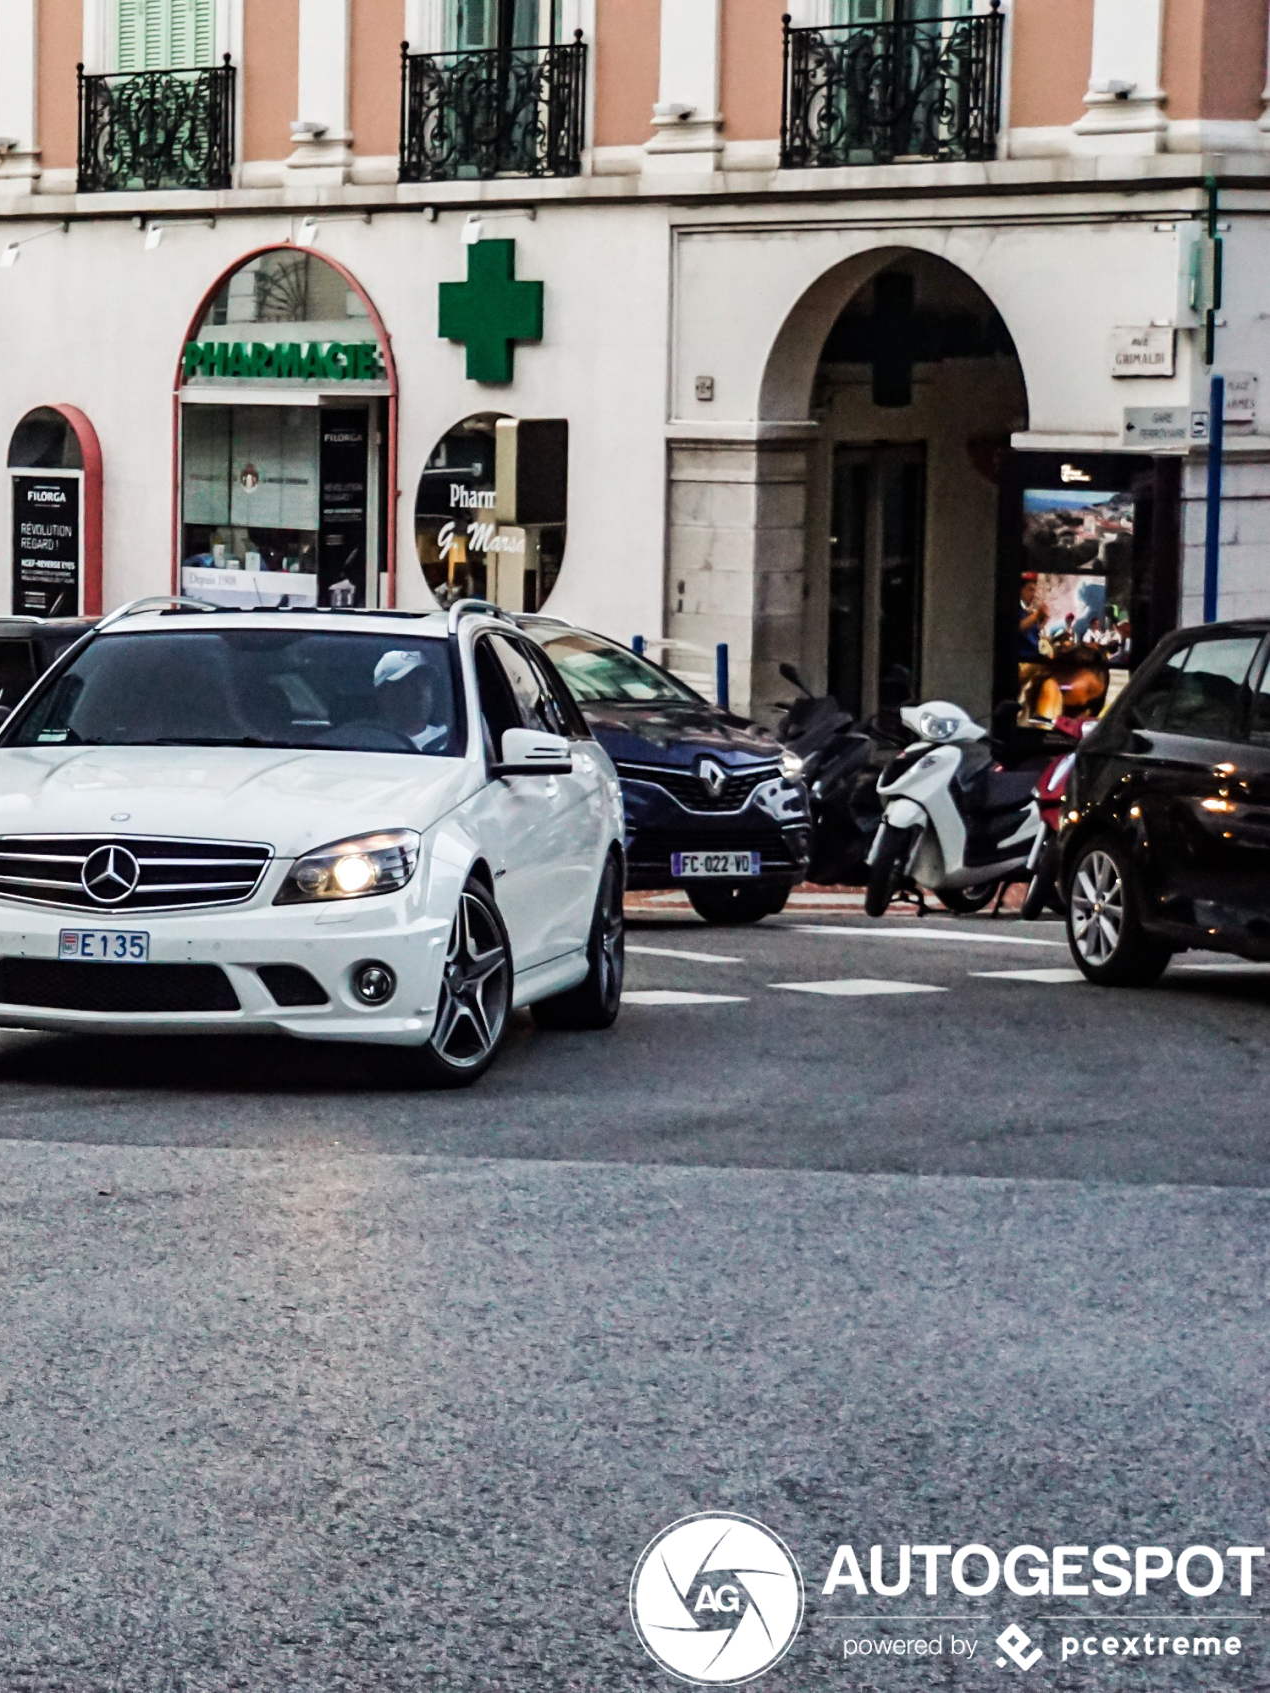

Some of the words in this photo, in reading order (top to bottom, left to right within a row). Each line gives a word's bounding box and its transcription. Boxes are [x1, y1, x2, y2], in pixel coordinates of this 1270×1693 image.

[184, 341, 377, 380] PHARMACIE
[1115, 352, 1166, 366] GRIMALDI
[27, 491, 66, 503] FILORGA
[20, 537, 54, 550] REGARD
[437, 521, 458, 560] G.
[81, 933, 144, 958] E135
